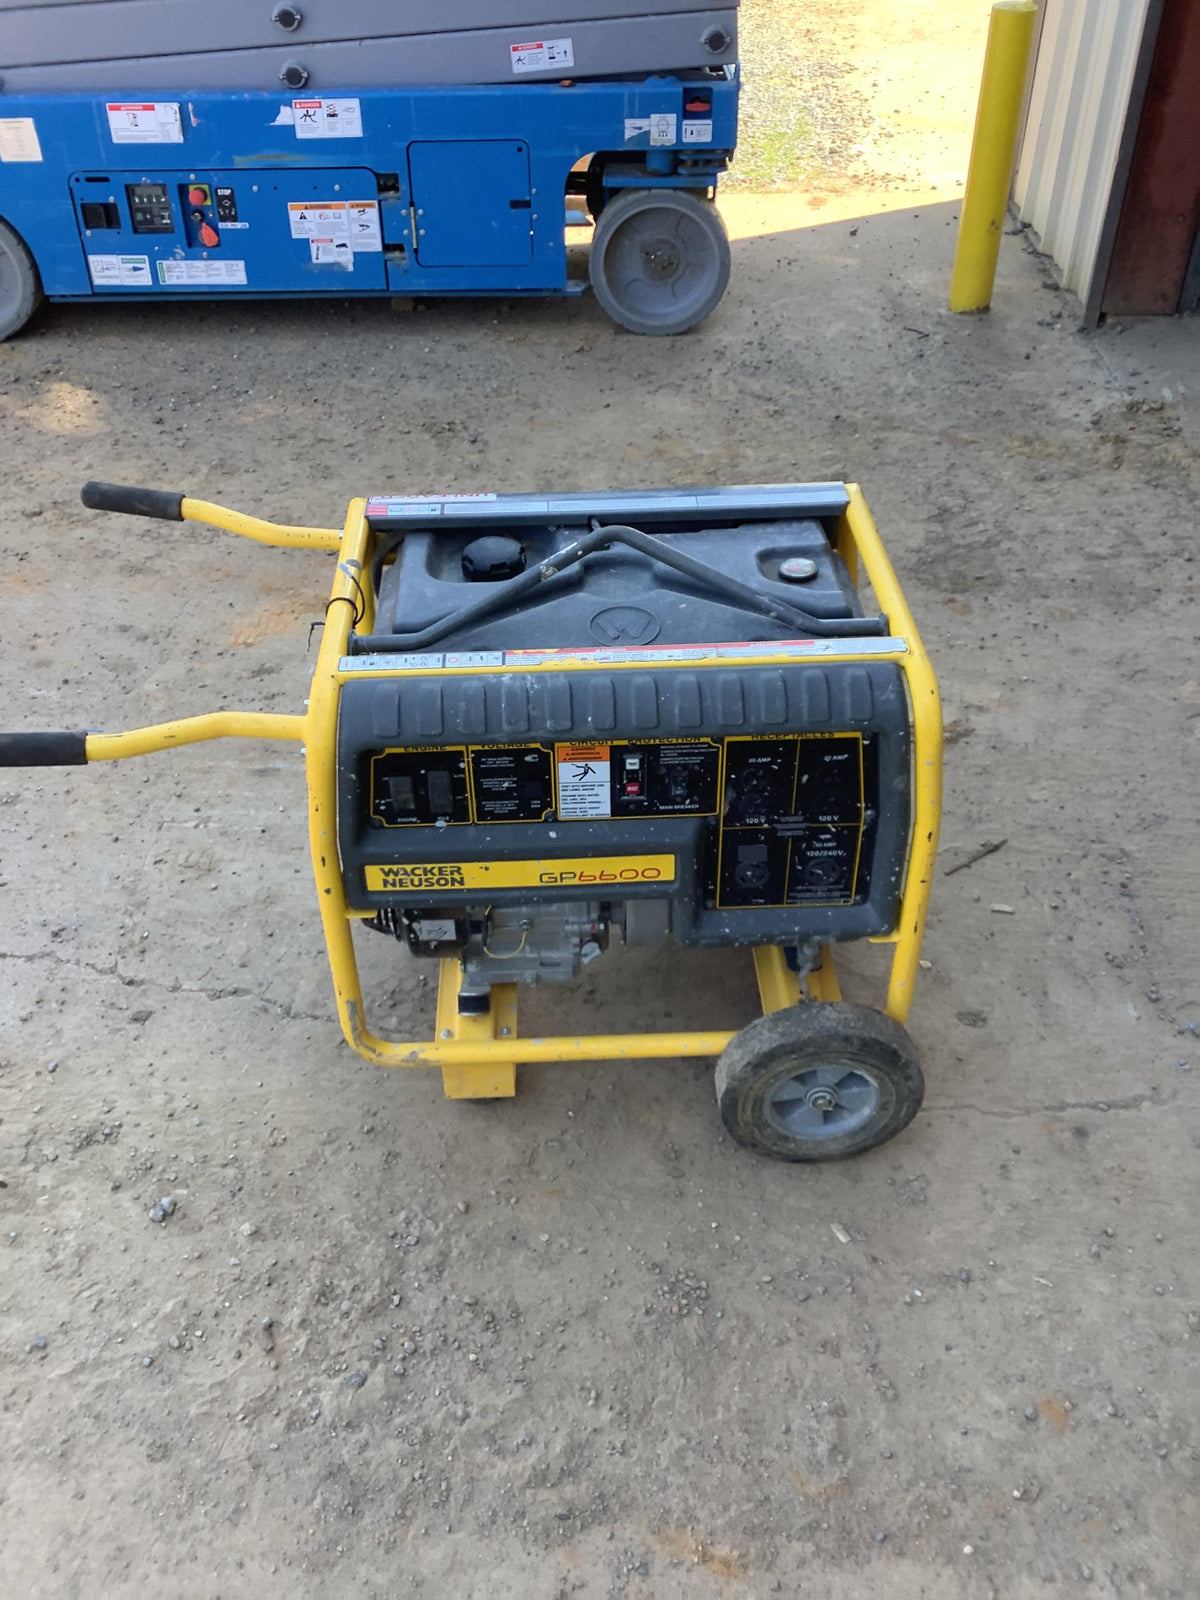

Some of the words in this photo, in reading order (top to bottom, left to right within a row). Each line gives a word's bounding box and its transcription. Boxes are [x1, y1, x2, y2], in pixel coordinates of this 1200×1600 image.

[819, 814, 834, 822] 120
[379, 865, 464, 877] WACKER
[540, 867, 661, 883] GP6600
[382, 877, 465, 888] NEUSON
